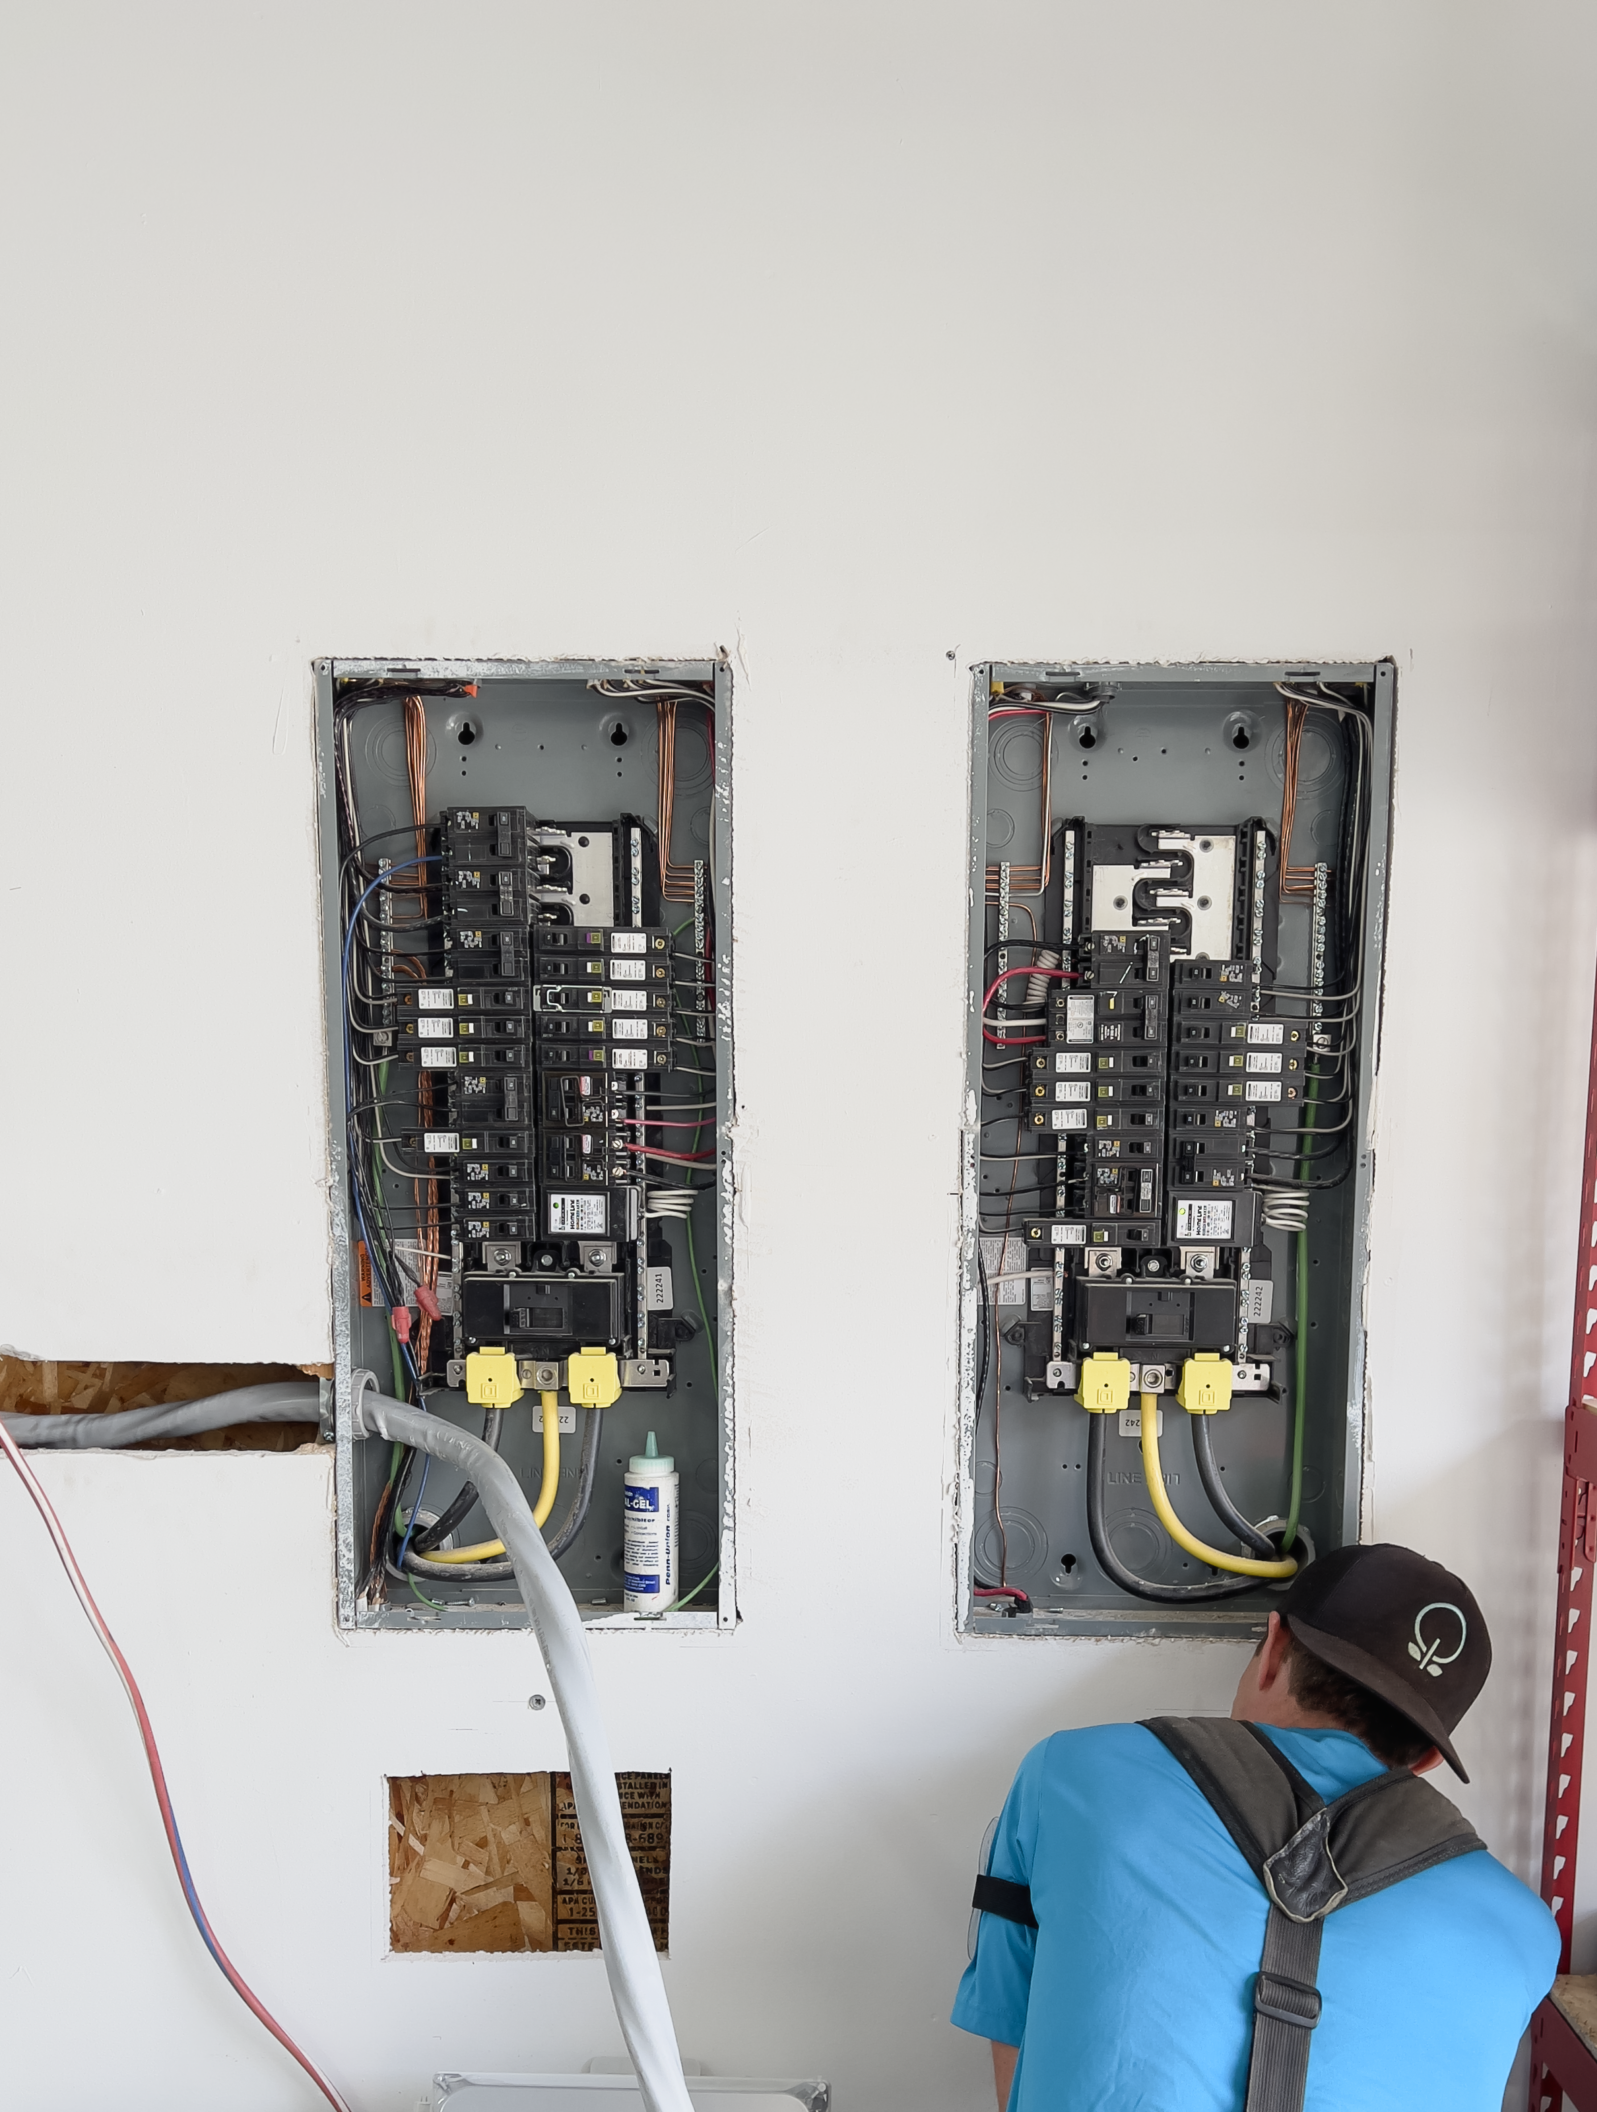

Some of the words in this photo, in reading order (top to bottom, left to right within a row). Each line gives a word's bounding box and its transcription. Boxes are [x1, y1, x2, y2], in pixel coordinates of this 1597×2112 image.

[655, 1272, 664, 1304] 222241
[1253, 1286, 1263, 1317] 222242
[1125, 1419, 1141, 1427] 242
[1107, 1471, 1142, 1485] LINE
[658, 1782, 668, 1790] IN
[621, 1801, 667, 1810] ENDATION
[561, 1896, 580, 1906] APA
[568, 1907, 597, 1918] 1-25
[567, 1926, 597, 1936] THIS
